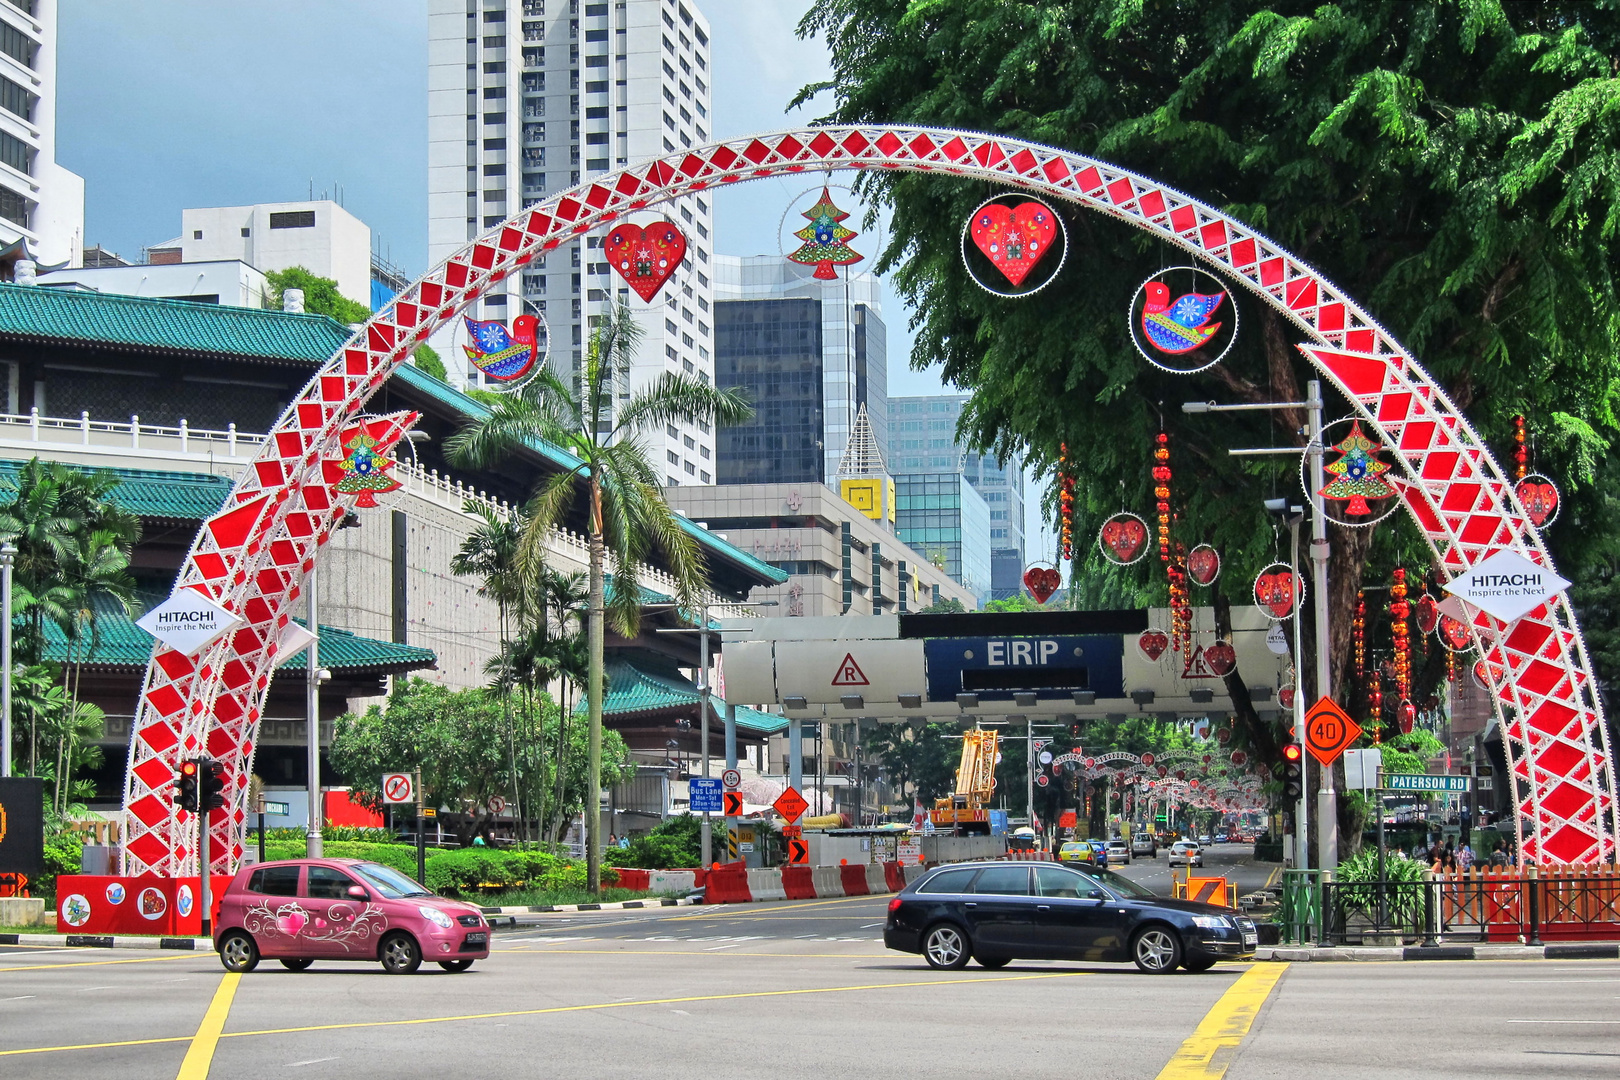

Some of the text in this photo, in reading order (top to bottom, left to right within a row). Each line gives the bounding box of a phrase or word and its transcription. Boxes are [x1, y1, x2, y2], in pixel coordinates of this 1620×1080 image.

[754, 538, 801, 553] PLAZA
[1472, 574, 1541, 587] HITACHI
[1468, 586, 1546, 598] Inspire the Next
[159, 611, 214, 622] HITACHI
[155, 622, 217, 633] Inspire the Next
[1195, 659, 1207, 674] R
[844, 666, 857, 681] R
[1315, 723, 1336, 740] 40
[1392, 776, 1464, 789] PATERSON RD
[690, 786, 721, 795] Bus Lane
